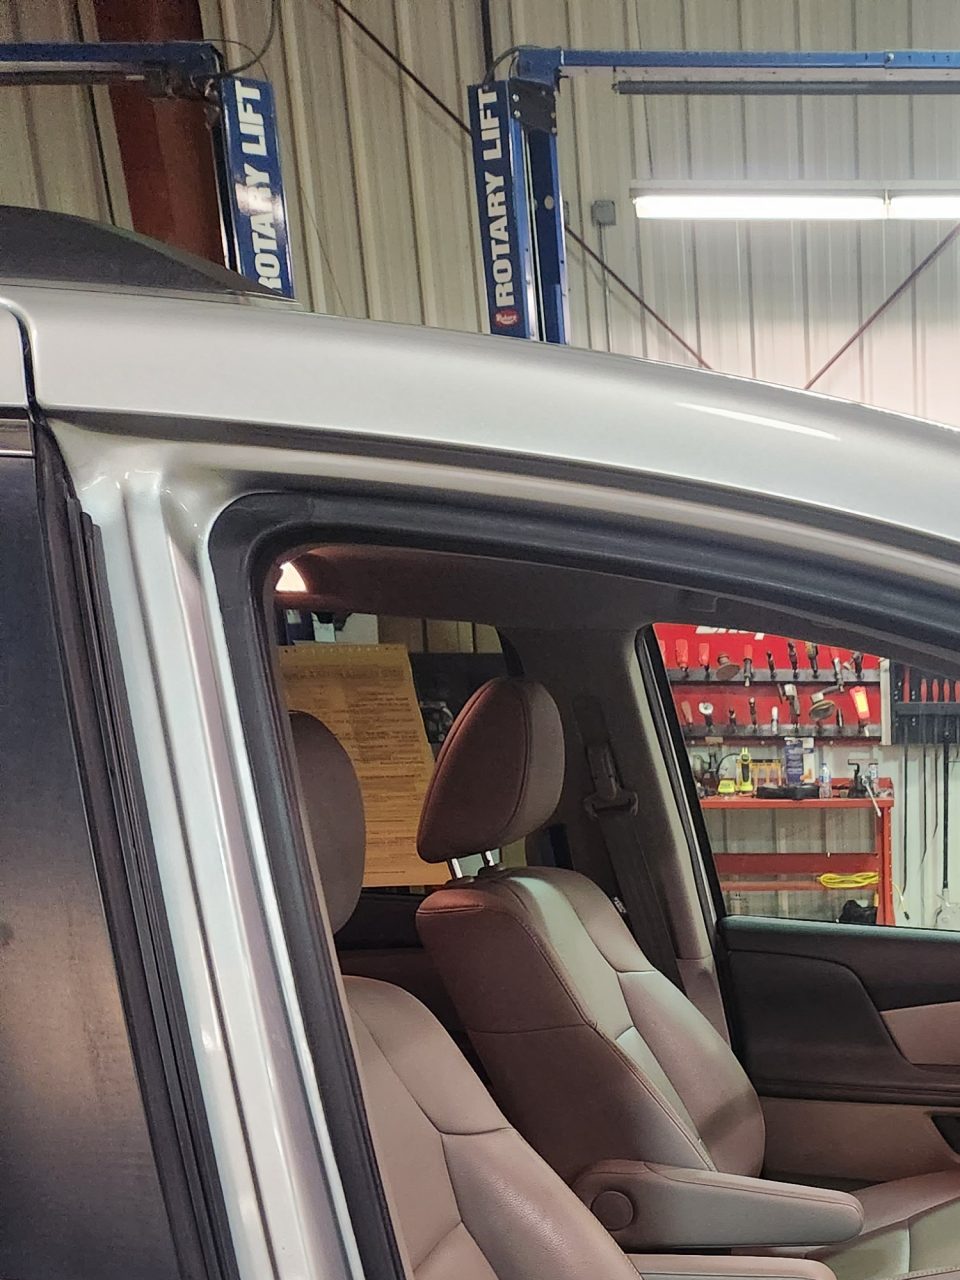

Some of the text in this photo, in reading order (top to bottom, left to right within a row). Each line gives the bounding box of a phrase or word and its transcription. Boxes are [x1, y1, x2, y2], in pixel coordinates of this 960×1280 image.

[235, 80, 268, 156] LIFT
[478, 88, 515, 307] ROTARY LIFT
